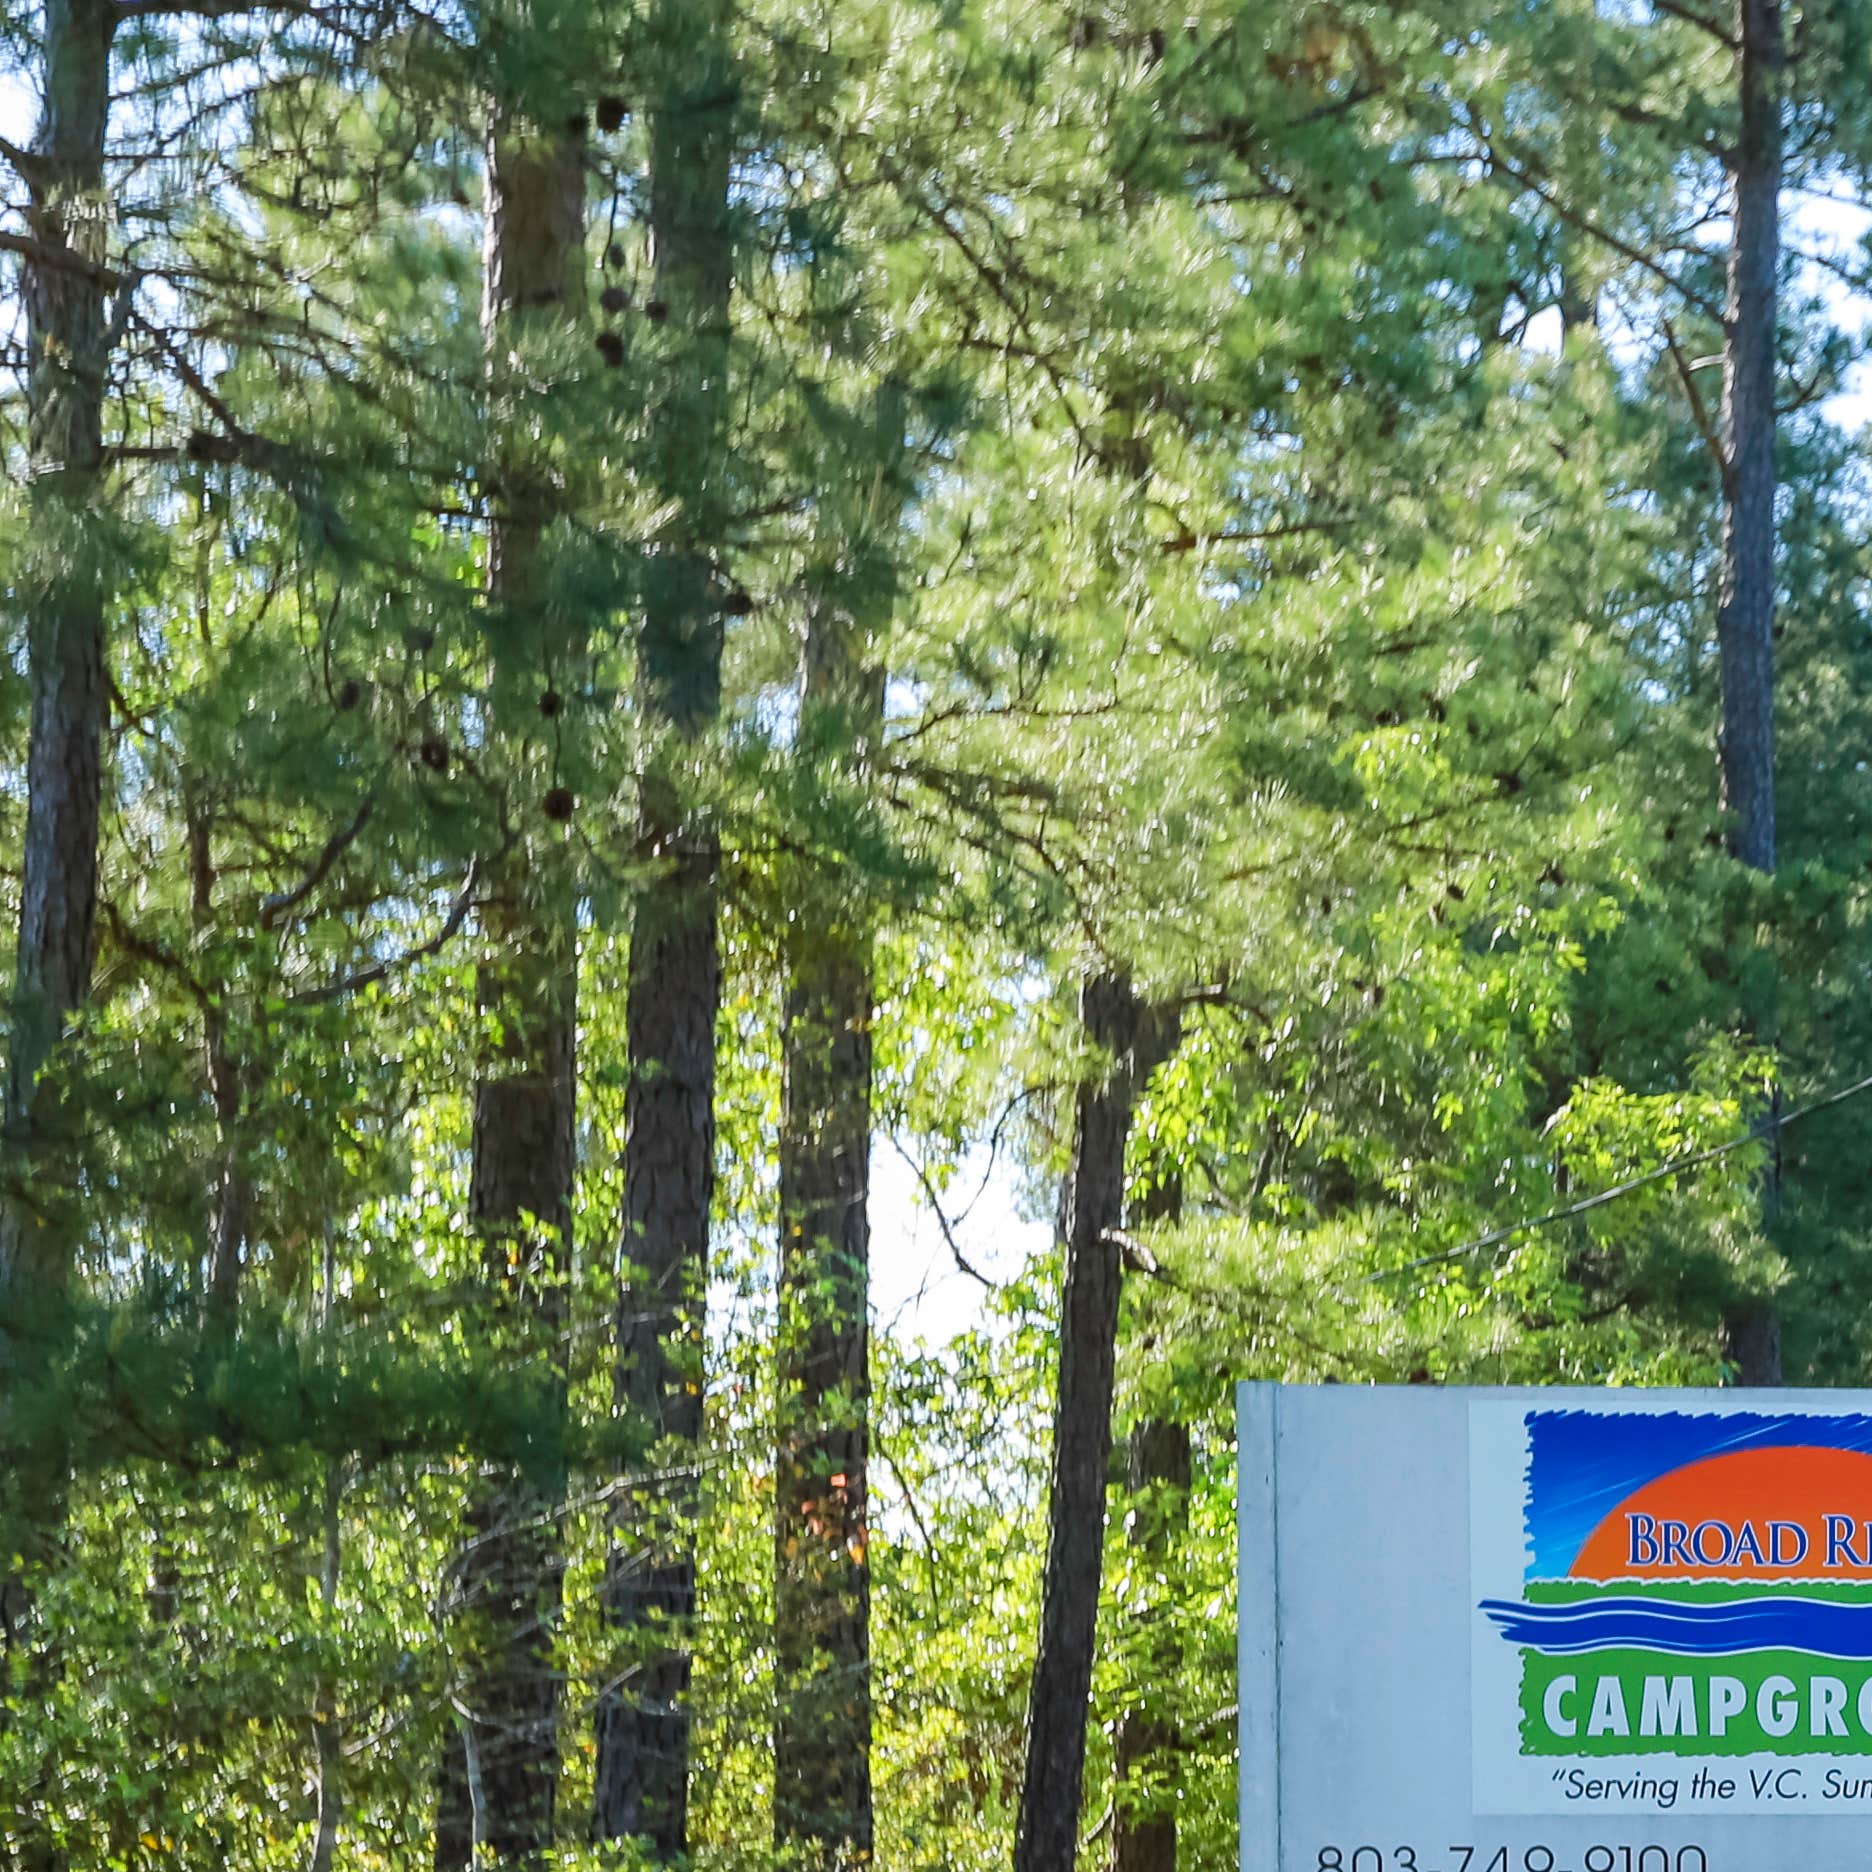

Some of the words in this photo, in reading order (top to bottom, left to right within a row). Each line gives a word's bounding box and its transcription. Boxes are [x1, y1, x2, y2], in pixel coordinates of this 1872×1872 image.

[1625, 1513, 1809, 1567] BROAD
[1690, 1767, 1736, 1801] the
[1749, 1769, 1807, 1801] V.C.
